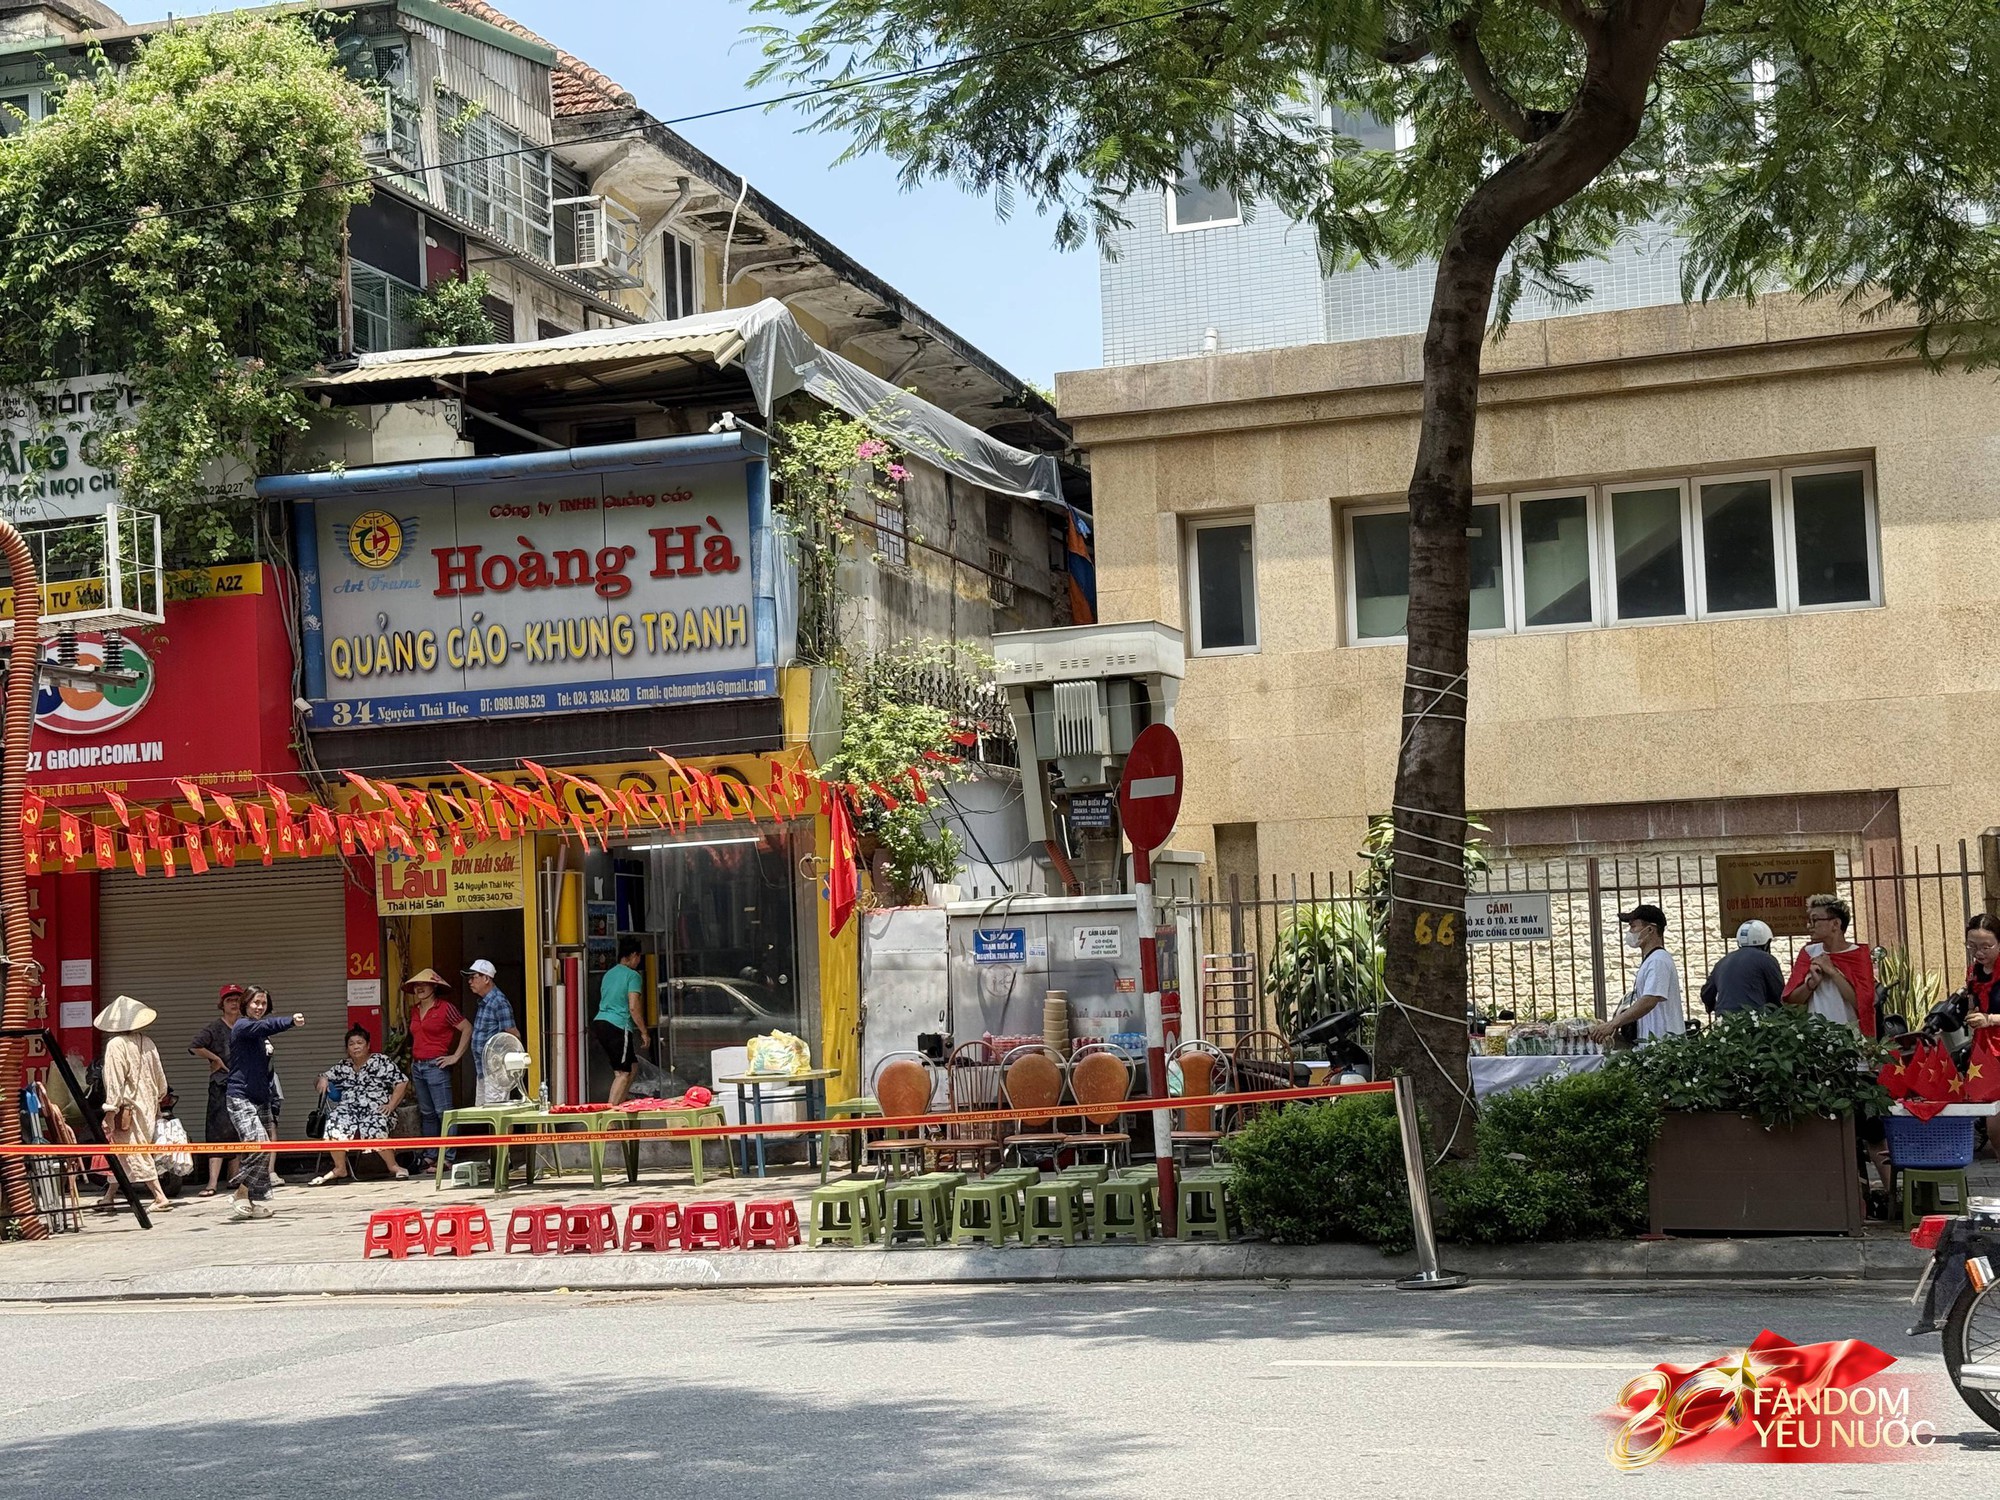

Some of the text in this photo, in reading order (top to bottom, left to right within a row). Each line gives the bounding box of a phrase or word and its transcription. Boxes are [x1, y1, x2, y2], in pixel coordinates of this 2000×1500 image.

[50, 476, 85, 499] MỌI
[490, 502, 532, 518] Công
[538, 501, 553, 516] ty
[558, 497, 597, 512] TNHH
[661, 486, 693, 503] cáo
[431, 535, 636, 600] Hoàng
[648, 515, 741, 579] Hà
[216, 575, 243, 592] A2Z
[333, 579, 364, 594] Art
[51, 591, 71, 608] TƯ
[331, 611, 440, 680] QUẢNG
[640, 603, 749, 654] TRANH
[332, 701, 374, 726] 34
[419, 701, 444, 717] Thái
[447, 700, 469, 717] Học
[557, 692, 572, 706] Tel:
[573, 691, 588, 705] 024
[636, 685, 662, 701] Email:
[663, 678, 767, 700] qchoangha34@gmail.com
[46, 740, 163, 771] GROUP.COM.VN
[381, 853, 448, 900] Lẩu
[454, 882, 464, 891] 34
[1753, 871, 1798, 886] VTDF
[1486, 899, 1513, 915] CẤM!
[1415, 911, 1455, 946] 66
[1475, 918, 1485, 926] XE
[1509, 916, 1518, 924] XE
[1521, 913, 1538, 924] MÁY
[1509, 927, 1521, 936] CƠ
[1522, 926, 1544, 935] QUAN
[350, 952, 376, 976] 34
